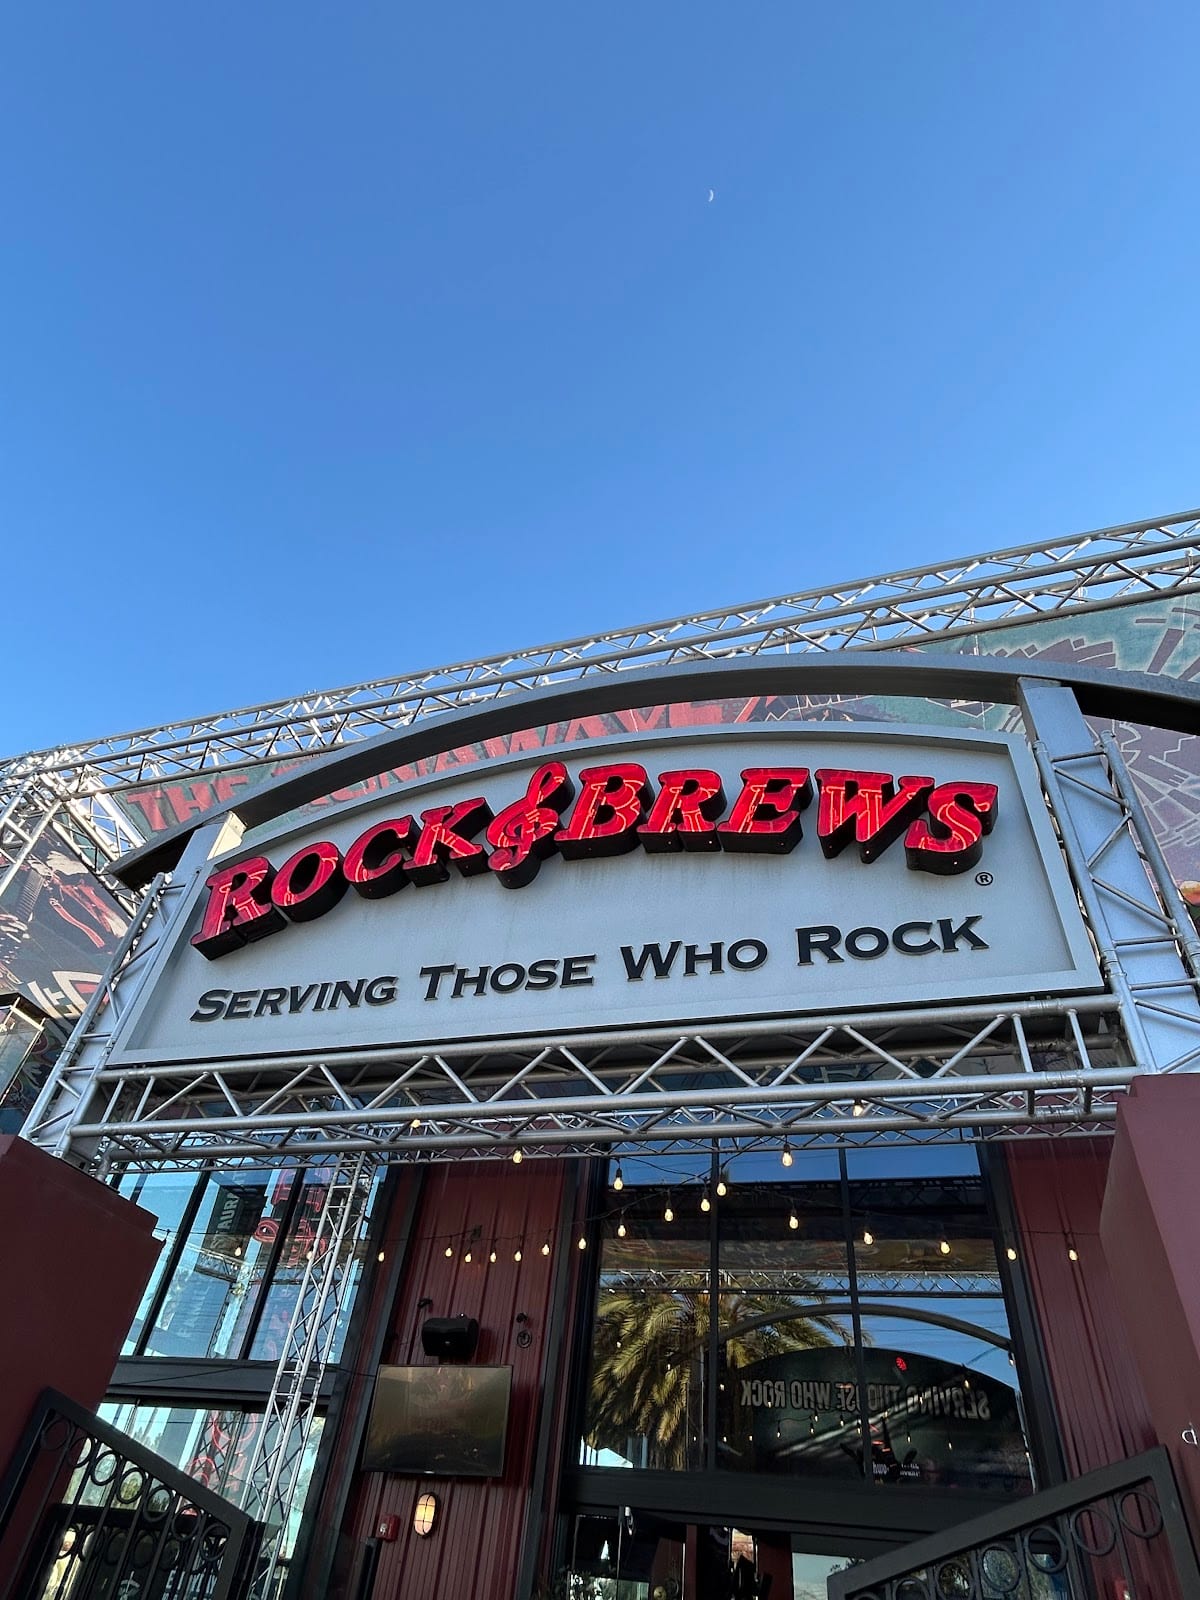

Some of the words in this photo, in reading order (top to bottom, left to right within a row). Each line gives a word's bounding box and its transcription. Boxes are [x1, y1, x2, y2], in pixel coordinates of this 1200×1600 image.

[190, 797, 490, 958] ROCK
[556, 763, 999, 872] BREWS
[190, 975, 399, 1022] SERVING
[419, 953, 597, 1001] THOSE
[620, 938, 768, 982] WHO
[795, 915, 989, 966] ROCK
